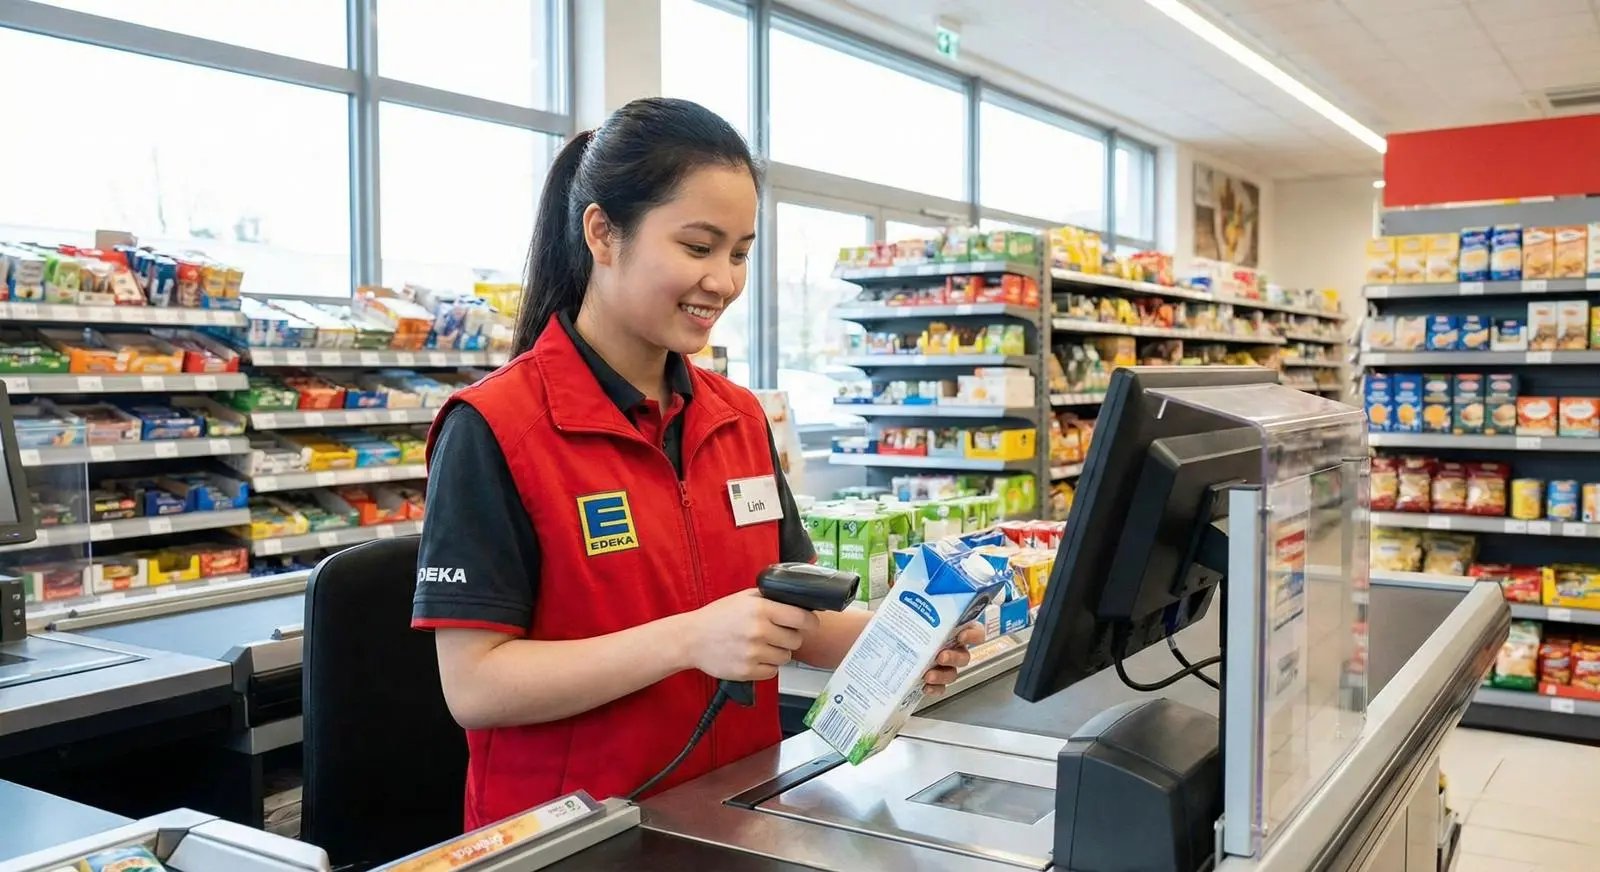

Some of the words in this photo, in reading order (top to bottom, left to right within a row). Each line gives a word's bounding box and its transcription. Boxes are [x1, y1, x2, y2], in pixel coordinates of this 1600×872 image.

[747, 500, 765, 513] Linh
[591, 536, 634, 550] EDEKA
[418, 567, 467, 584] DEKA
